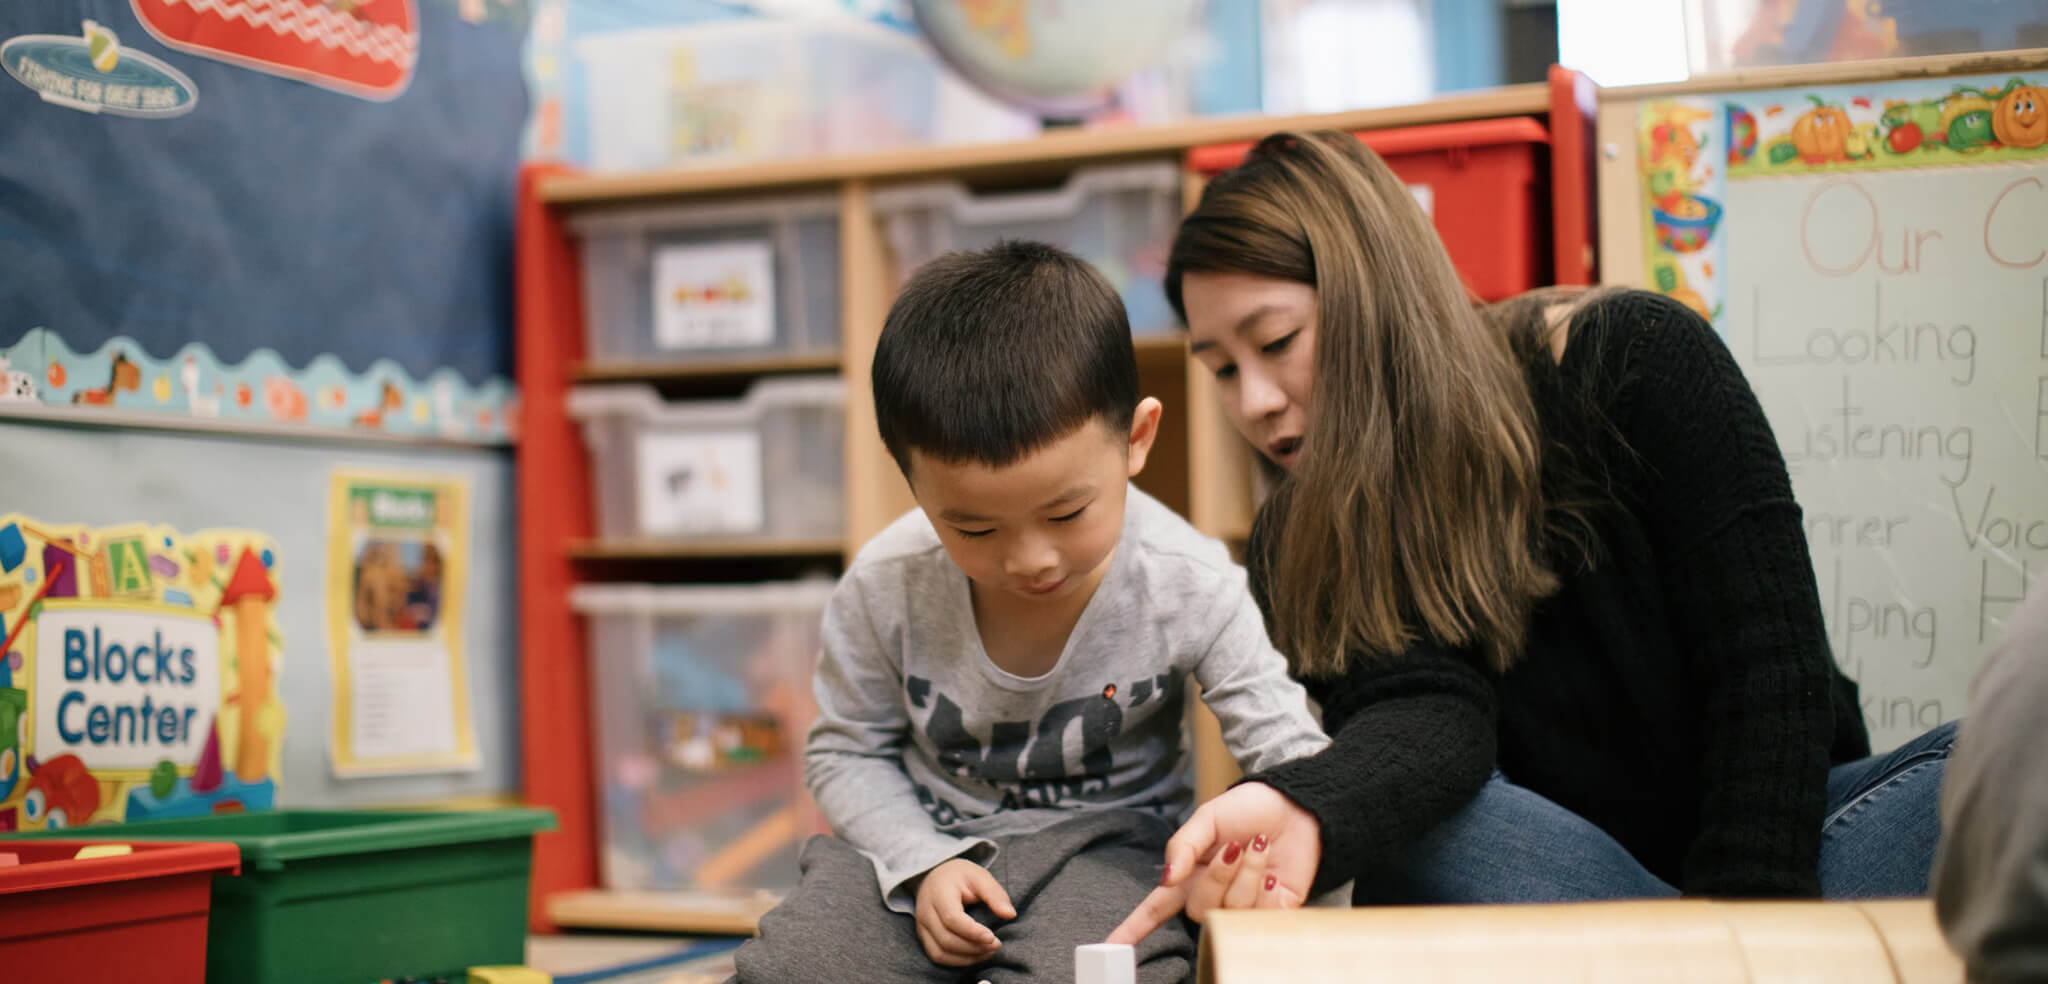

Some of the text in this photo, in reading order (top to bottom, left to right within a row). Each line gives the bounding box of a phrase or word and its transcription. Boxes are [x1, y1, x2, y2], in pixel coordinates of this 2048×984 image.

[1801, 174, 1943, 278] Our
[1751, 278, 1977, 386] Looking
[1808, 510, 1911, 548] nner
[1833, 558, 1937, 669] lping
[64, 626, 196, 683] Blocks
[57, 690, 197, 745] Center
